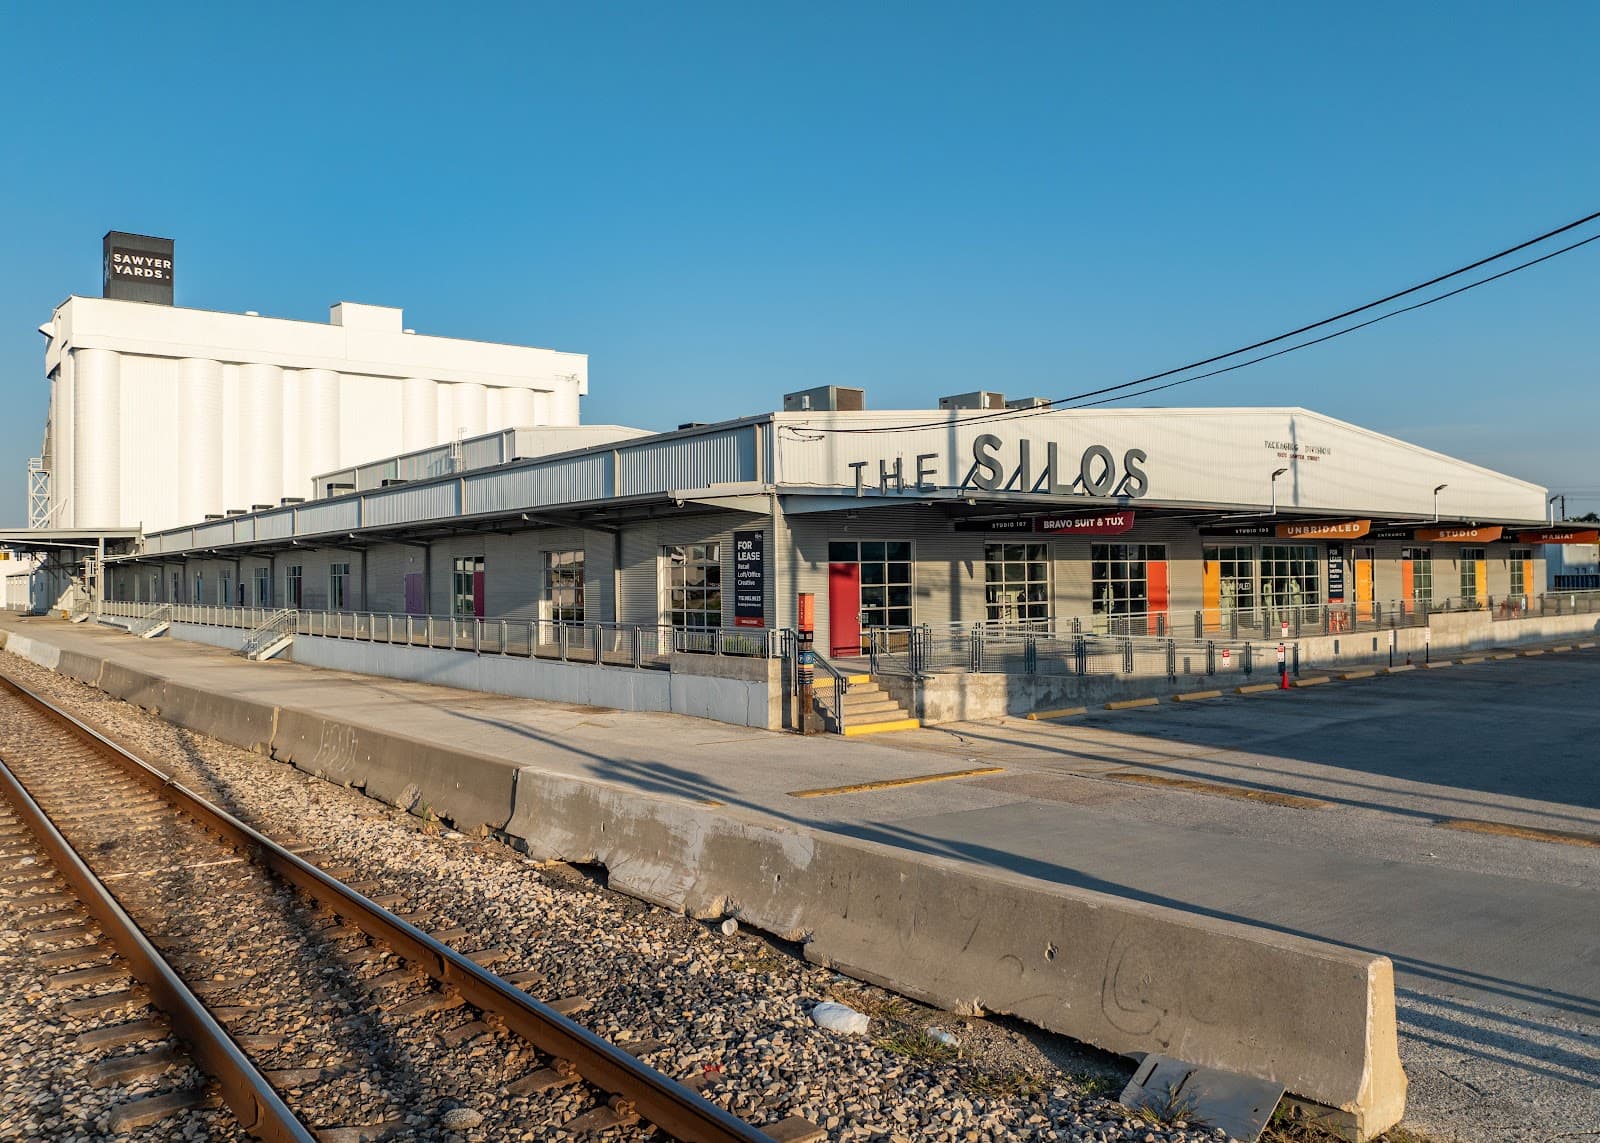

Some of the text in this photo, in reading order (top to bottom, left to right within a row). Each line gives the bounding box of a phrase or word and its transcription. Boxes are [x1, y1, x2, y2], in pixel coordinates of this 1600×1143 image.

[113, 253, 172, 269] SAWYER
[849, 433, 1148, 498] THE SILOS
[1043, 520, 1073, 529] BRAVO
[1074, 518, 1096, 528] SUIT
[1096, 518, 1104, 527] &
[1104, 516, 1125, 526] TUX
[1287, 523, 1361, 535] UNBRIDALED
[1439, 529, 1479, 538] STUDIO
[737, 541, 753, 550] FOR
[737, 551, 761, 561] LEASE
